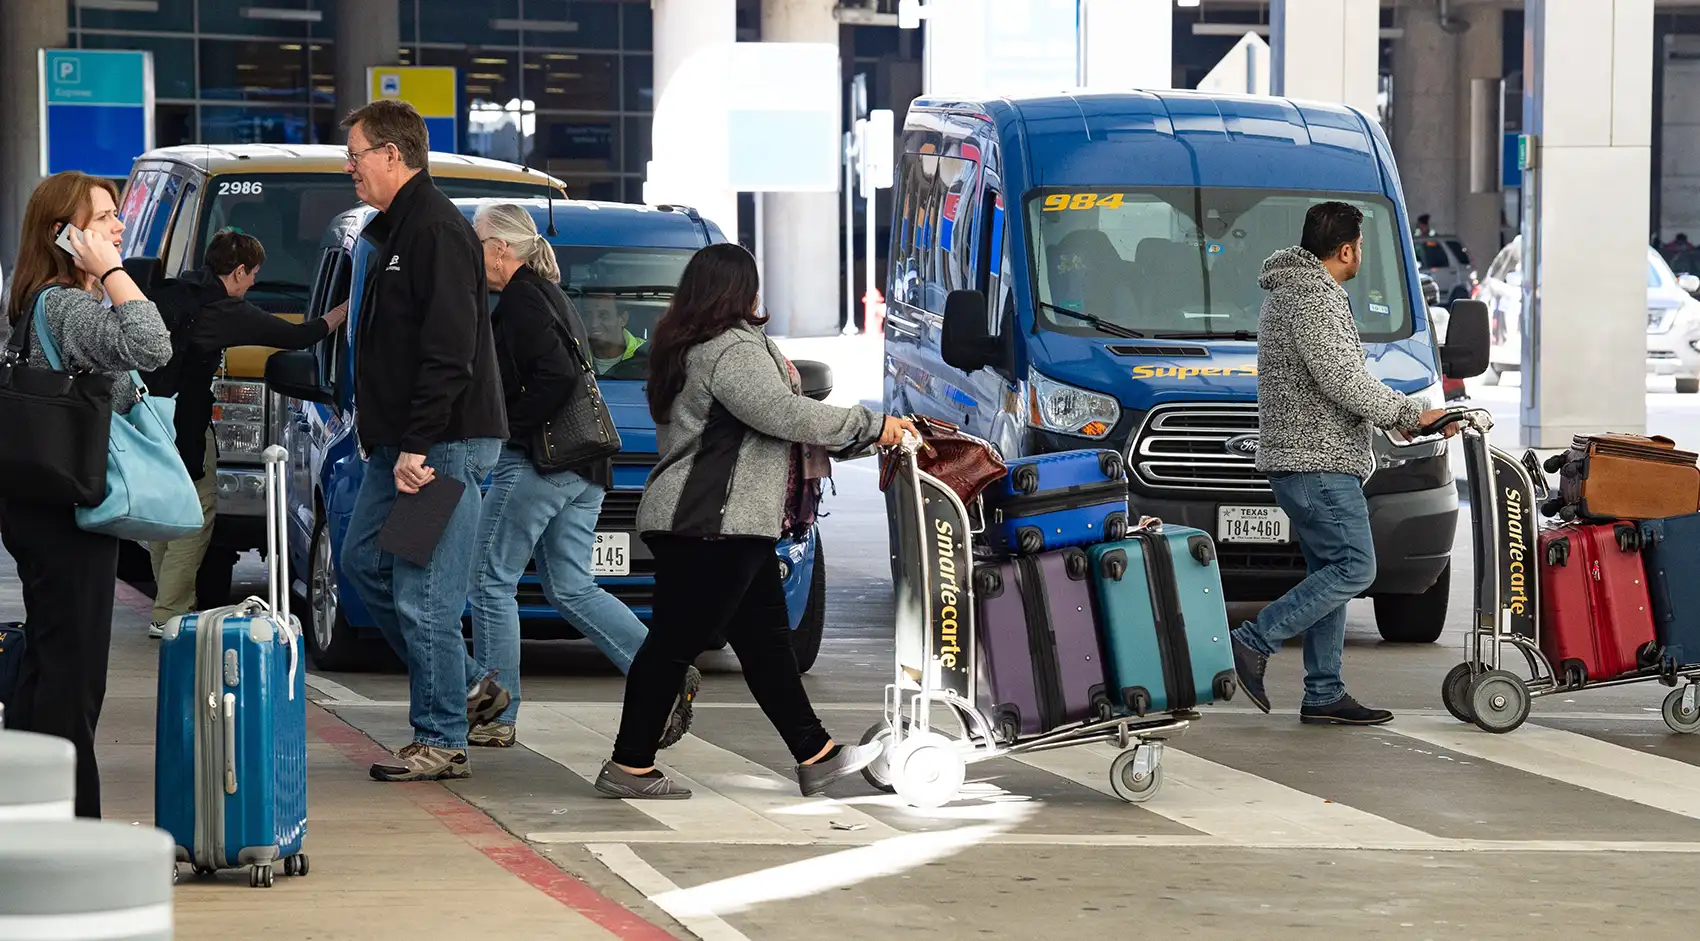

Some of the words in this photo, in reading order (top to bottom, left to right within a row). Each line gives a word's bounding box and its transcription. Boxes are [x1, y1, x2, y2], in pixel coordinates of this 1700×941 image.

[218, 181, 263, 195] 2986
[1043, 193, 1125, 212] 984
[1240, 508, 1268, 516] TEXAS
[592, 546, 624, 567] 145
[1505, 486, 1529, 615] smartecarte
[935, 518, 961, 669] smartecarte
